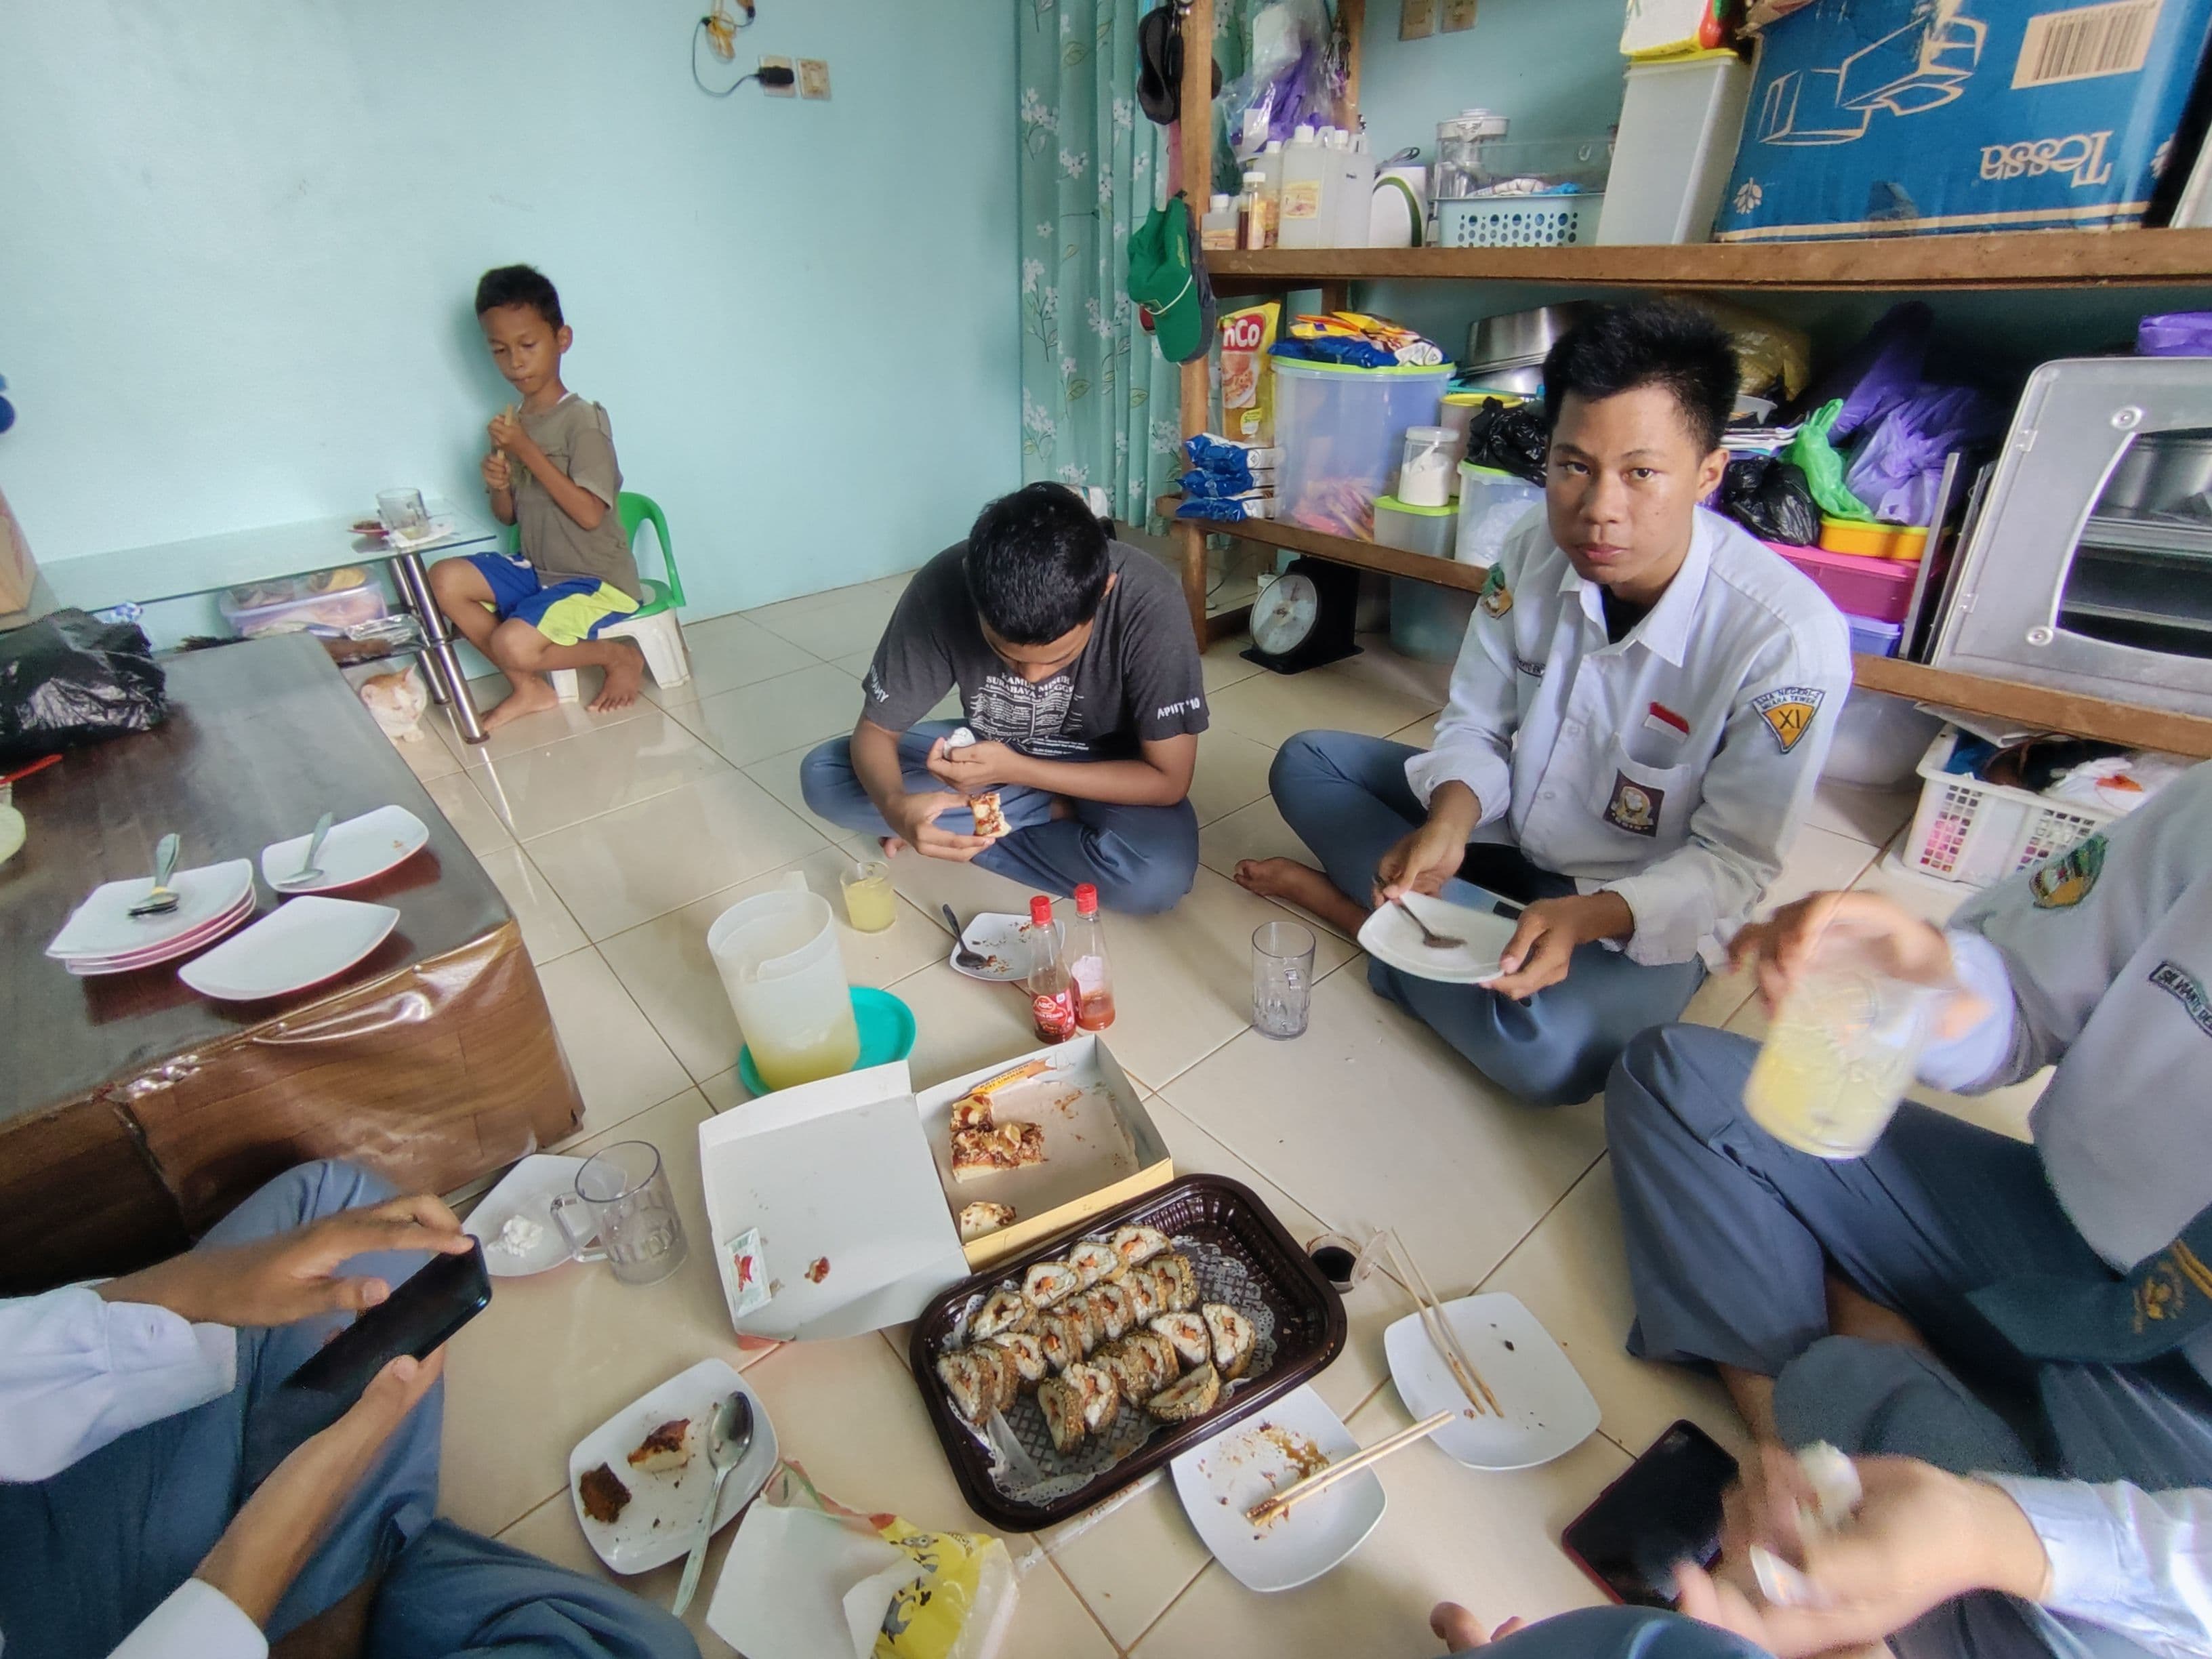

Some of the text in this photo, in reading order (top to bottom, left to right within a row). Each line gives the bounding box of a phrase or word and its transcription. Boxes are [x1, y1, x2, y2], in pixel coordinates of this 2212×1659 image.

[1980, 130, 2114, 188] Tessa
[1223, 319, 1260, 347] nCo
[986, 675, 1036, 699] SURABAYA
[1002, 672, 1036, 691] KAMUS
[1778, 709, 1801, 730] XI
[1037, 1001, 1053, 1009] ABC
